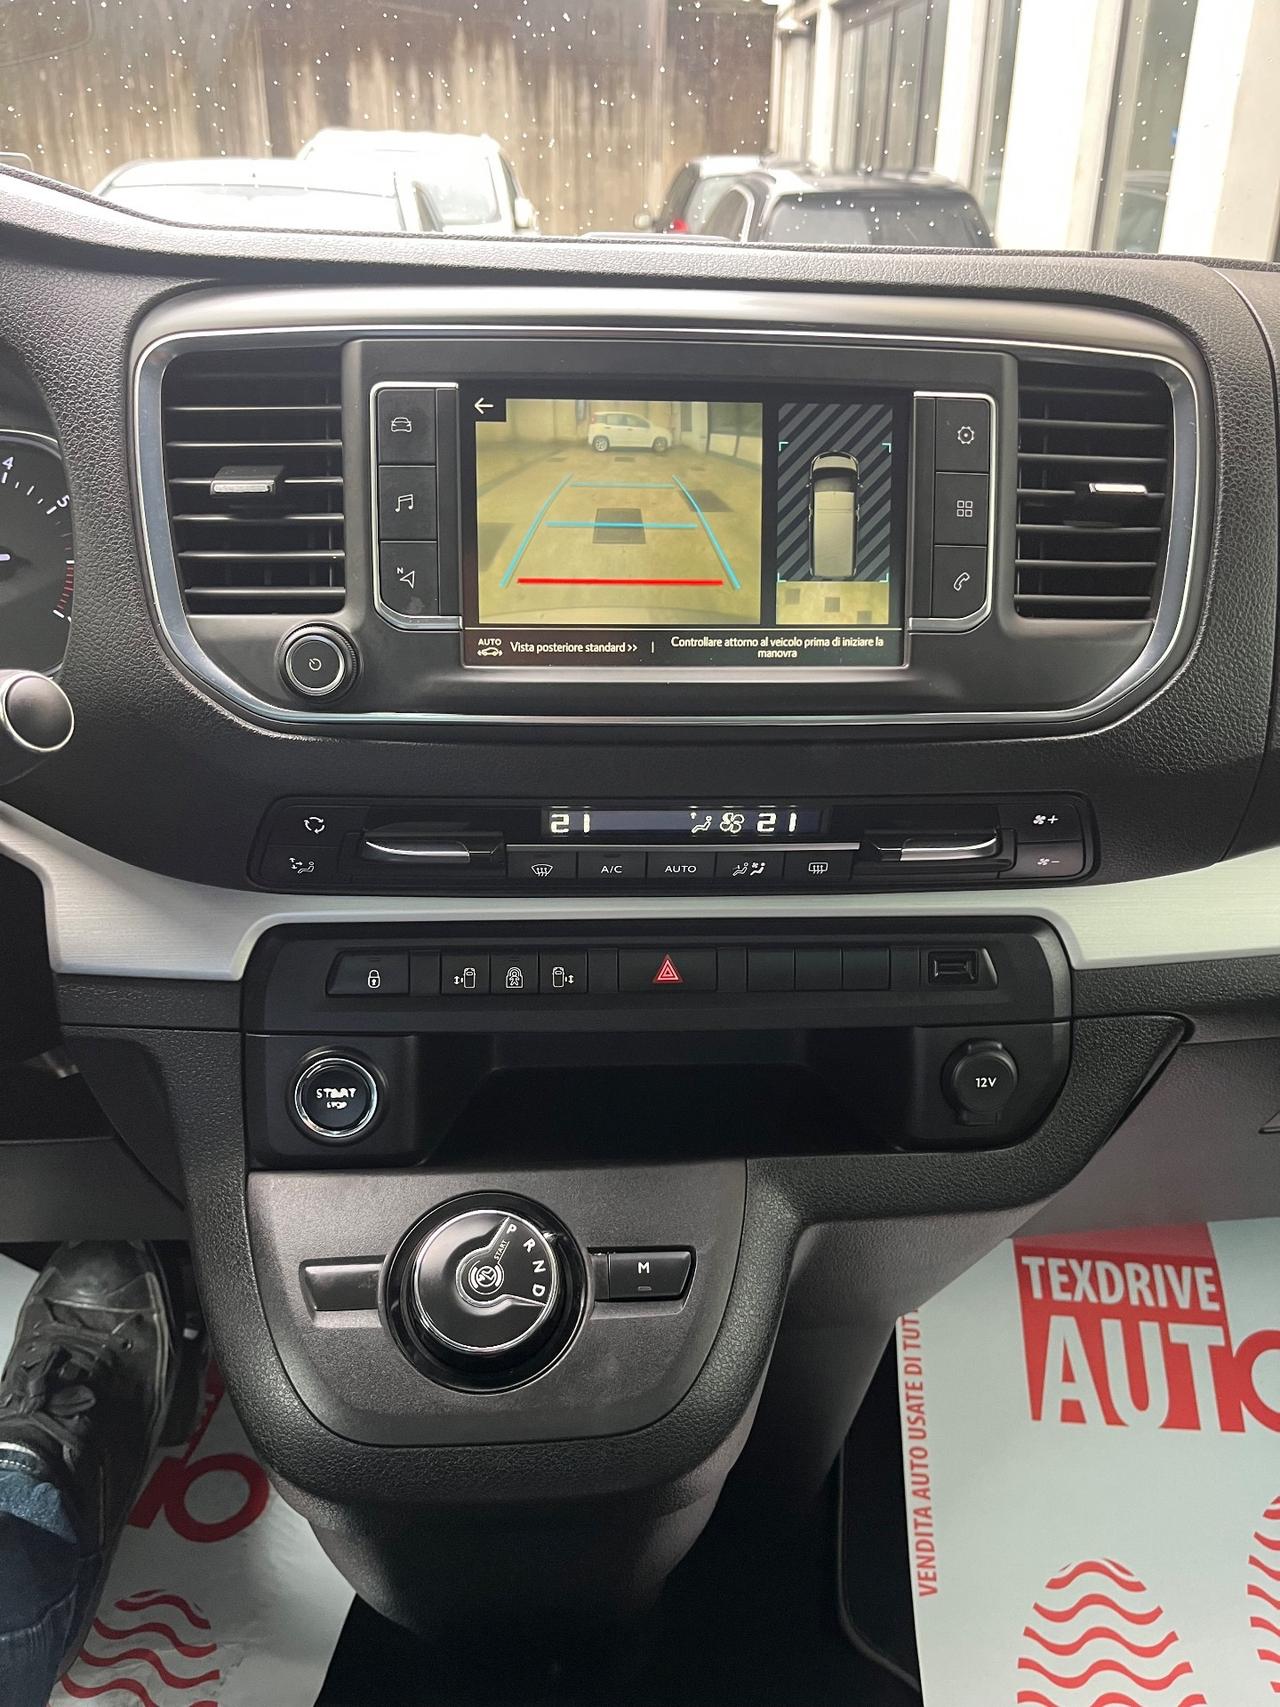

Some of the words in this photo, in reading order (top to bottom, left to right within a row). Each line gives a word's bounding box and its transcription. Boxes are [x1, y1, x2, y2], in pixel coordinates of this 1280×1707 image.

[2, 456, 14, 470] 4
[56, 494, 70, 507] 5
[478, 637, 502, 646] AUTO
[510, 642, 535, 652] Vista
[536, 642, 583, 654] posteriore
[585, 641, 626, 652] standard
[671, 636, 722, 647] Controllare
[724, 637, 758, 647] attorno
[760, 636, 768, 647] al
[770, 636, 801, 647] veicolo
[804, 637, 830, 650] prima
[832, 636, 841, 647] di
[842, 636, 874, 647] iniziare
[875, 636, 884, 647] la
[757, 649, 798, 658] manovra
[551, 813, 591, 833] 21
[757, 812, 797, 832] 21
[601, 864, 623, 874] A/C
[664, 864, 697, 873] AUTO
[975, 1077, 997, 1088] 12V
[506, 1223, 517, 1234] P
[493, 1240, 507, 1260] START
[523, 1238, 536, 1253] R
[532, 1260, 546, 1273] N
[637, 1261, 650, 1274] M
[532, 1283, 546, 1297] D
[1021, 1255, 1220, 1312] TEXDRIVE
[902, 1307, 921, 1351] TUT
[903, 1357, 922, 1375] DI
[905, 1381, 927, 1439] USATE
[909, 1446, 931, 1500] AUTO
[913, 1506, 938, 1597] VENDITA
